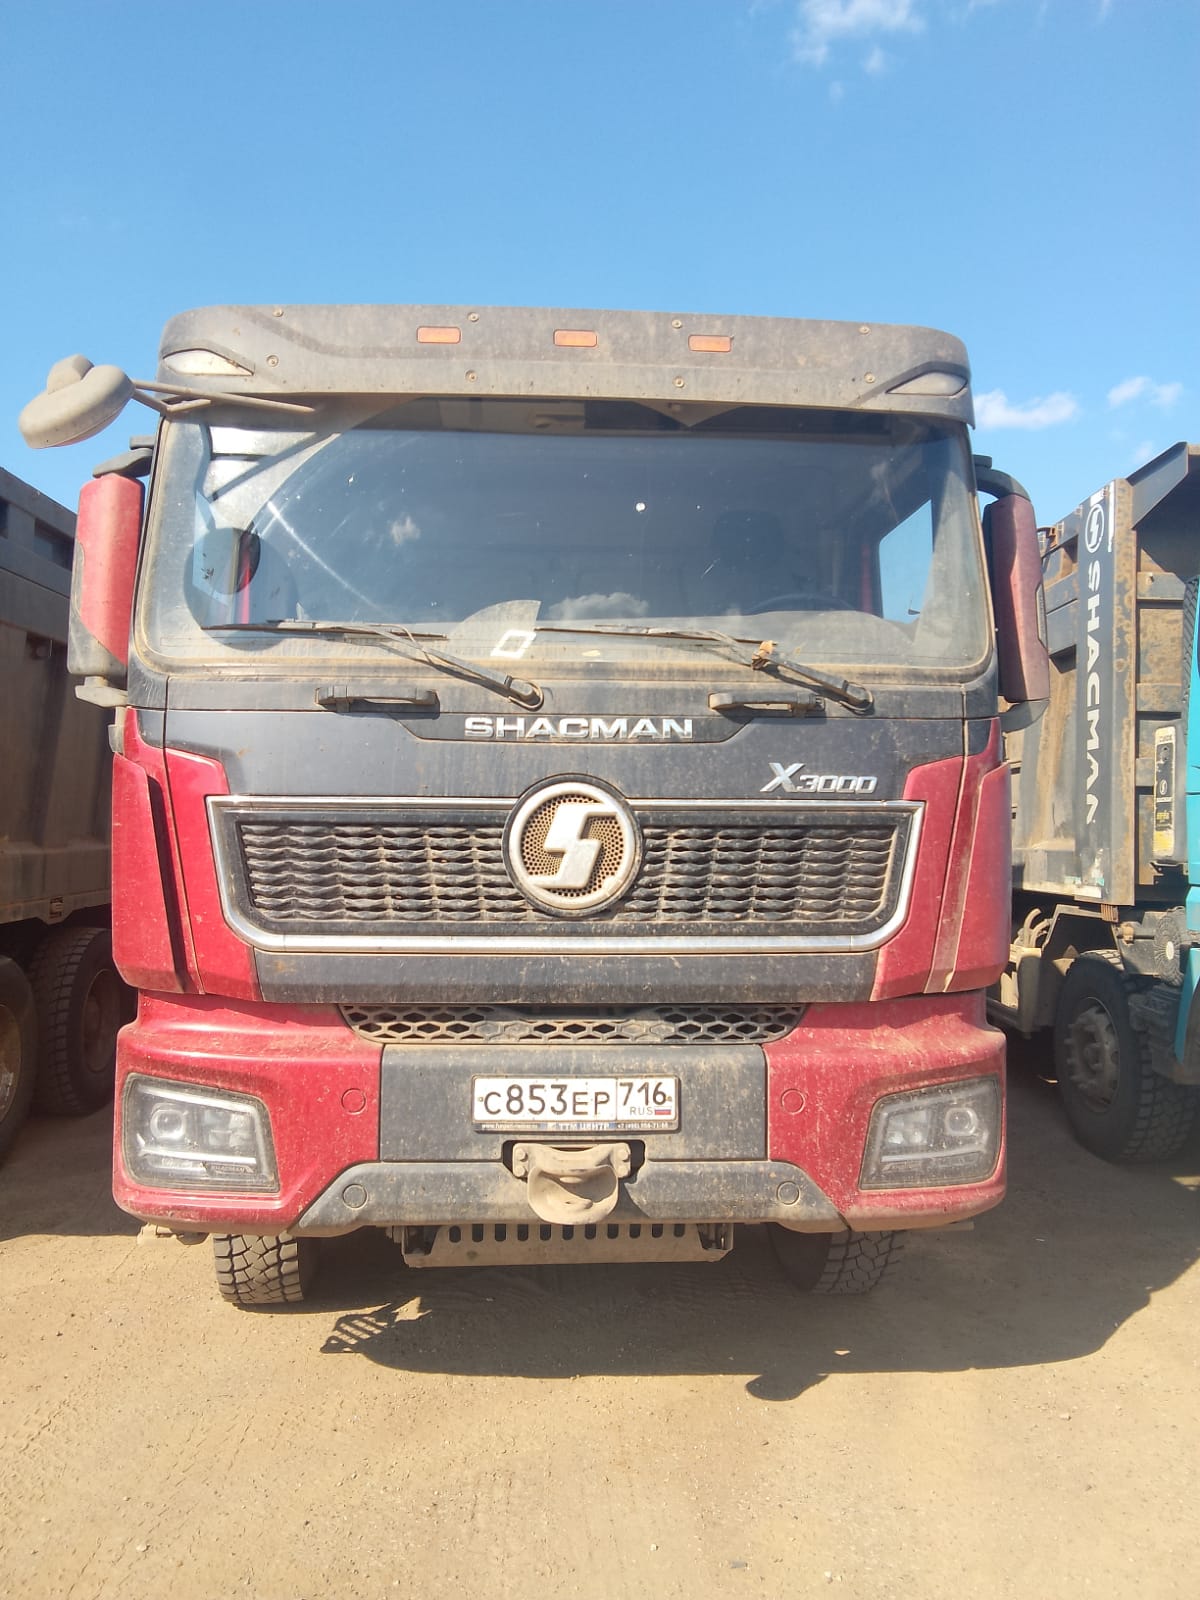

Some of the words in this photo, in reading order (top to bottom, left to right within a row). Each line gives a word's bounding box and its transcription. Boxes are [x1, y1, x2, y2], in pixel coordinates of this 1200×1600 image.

[464, 717, 694, 740] SHACMAN
[760, 762, 879, 795] X3000
[619, 1082, 667, 1106] 716
[629, 1106, 654, 1116] RUS
